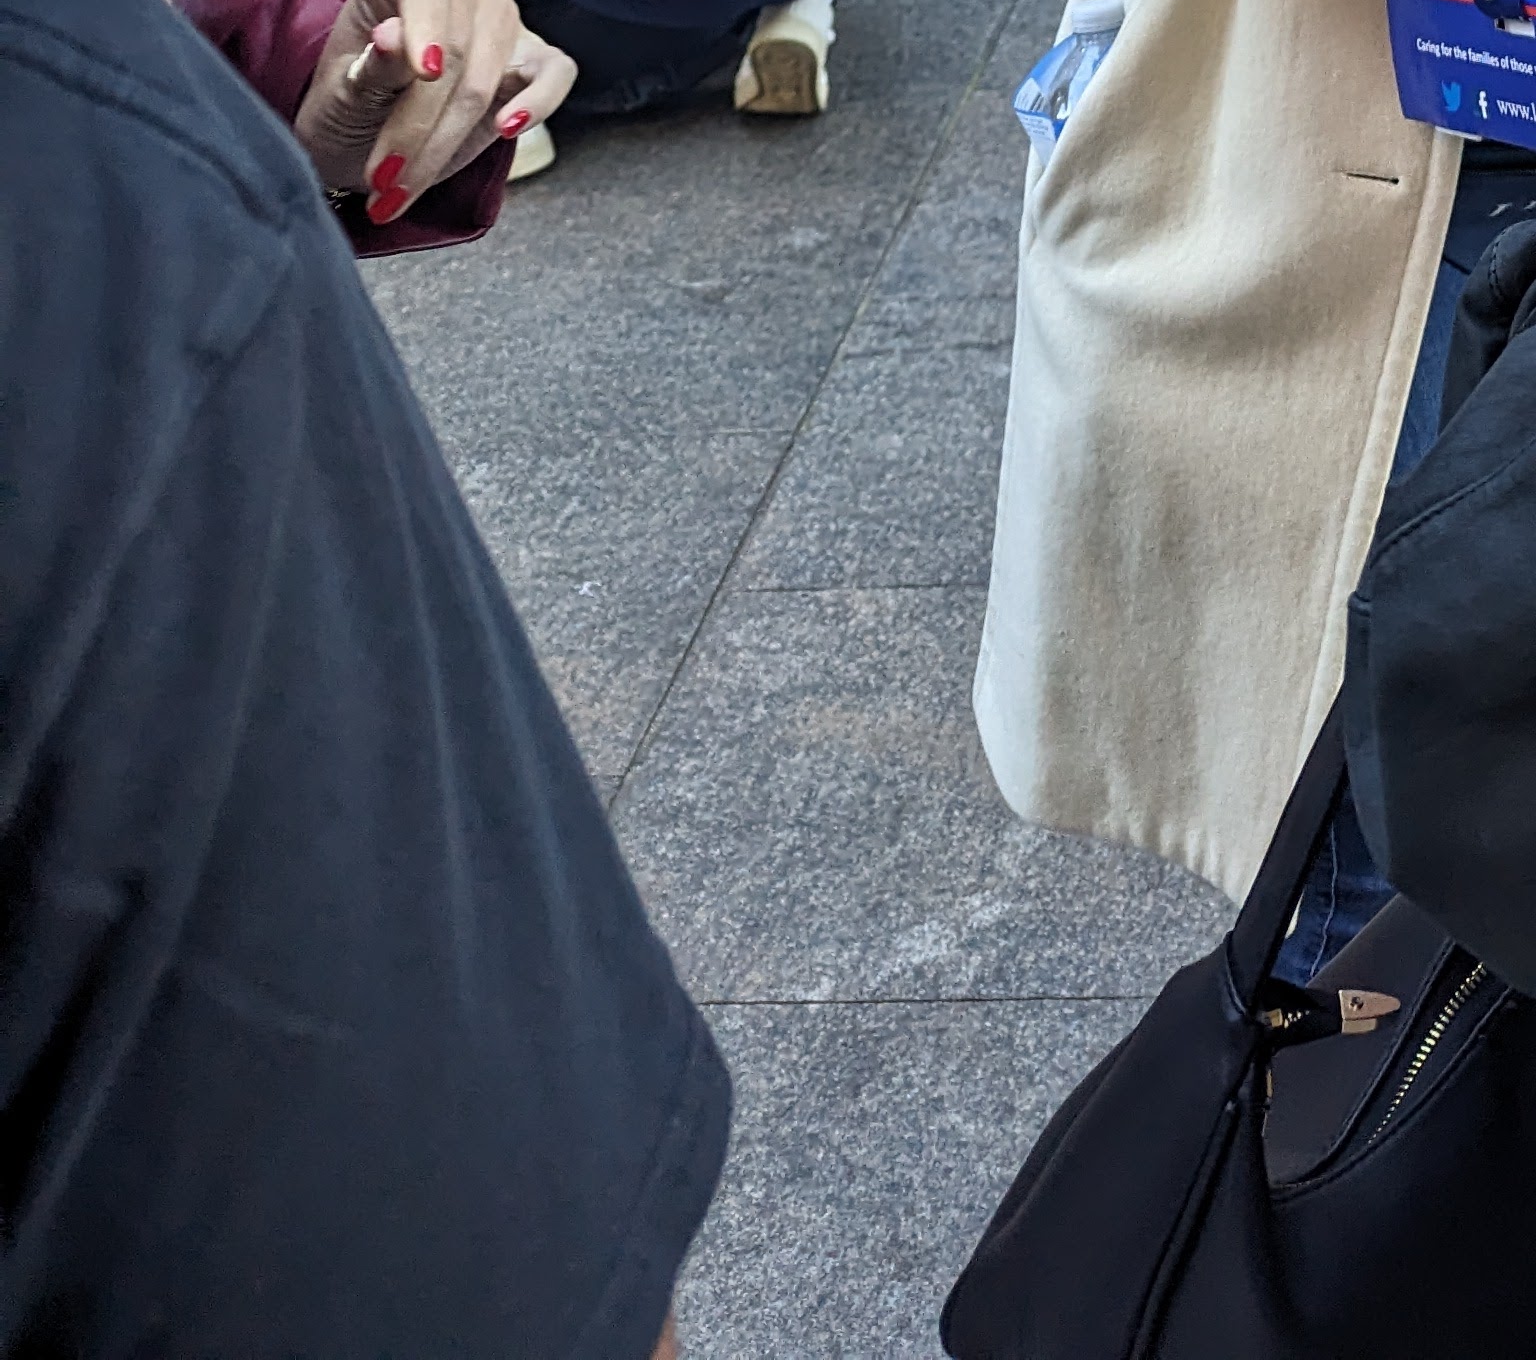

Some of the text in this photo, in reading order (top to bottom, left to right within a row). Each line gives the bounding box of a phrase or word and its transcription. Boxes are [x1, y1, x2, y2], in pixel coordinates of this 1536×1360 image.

[1416, 37, 1440, 58] Caring
[1441, 42, 1453, 57] for
[1453, 45, 1467, 60] the
[1468, 48, 1500, 67] families
[1501, 56, 1509, 69] of
[1510, 58, 1533, 75] those
